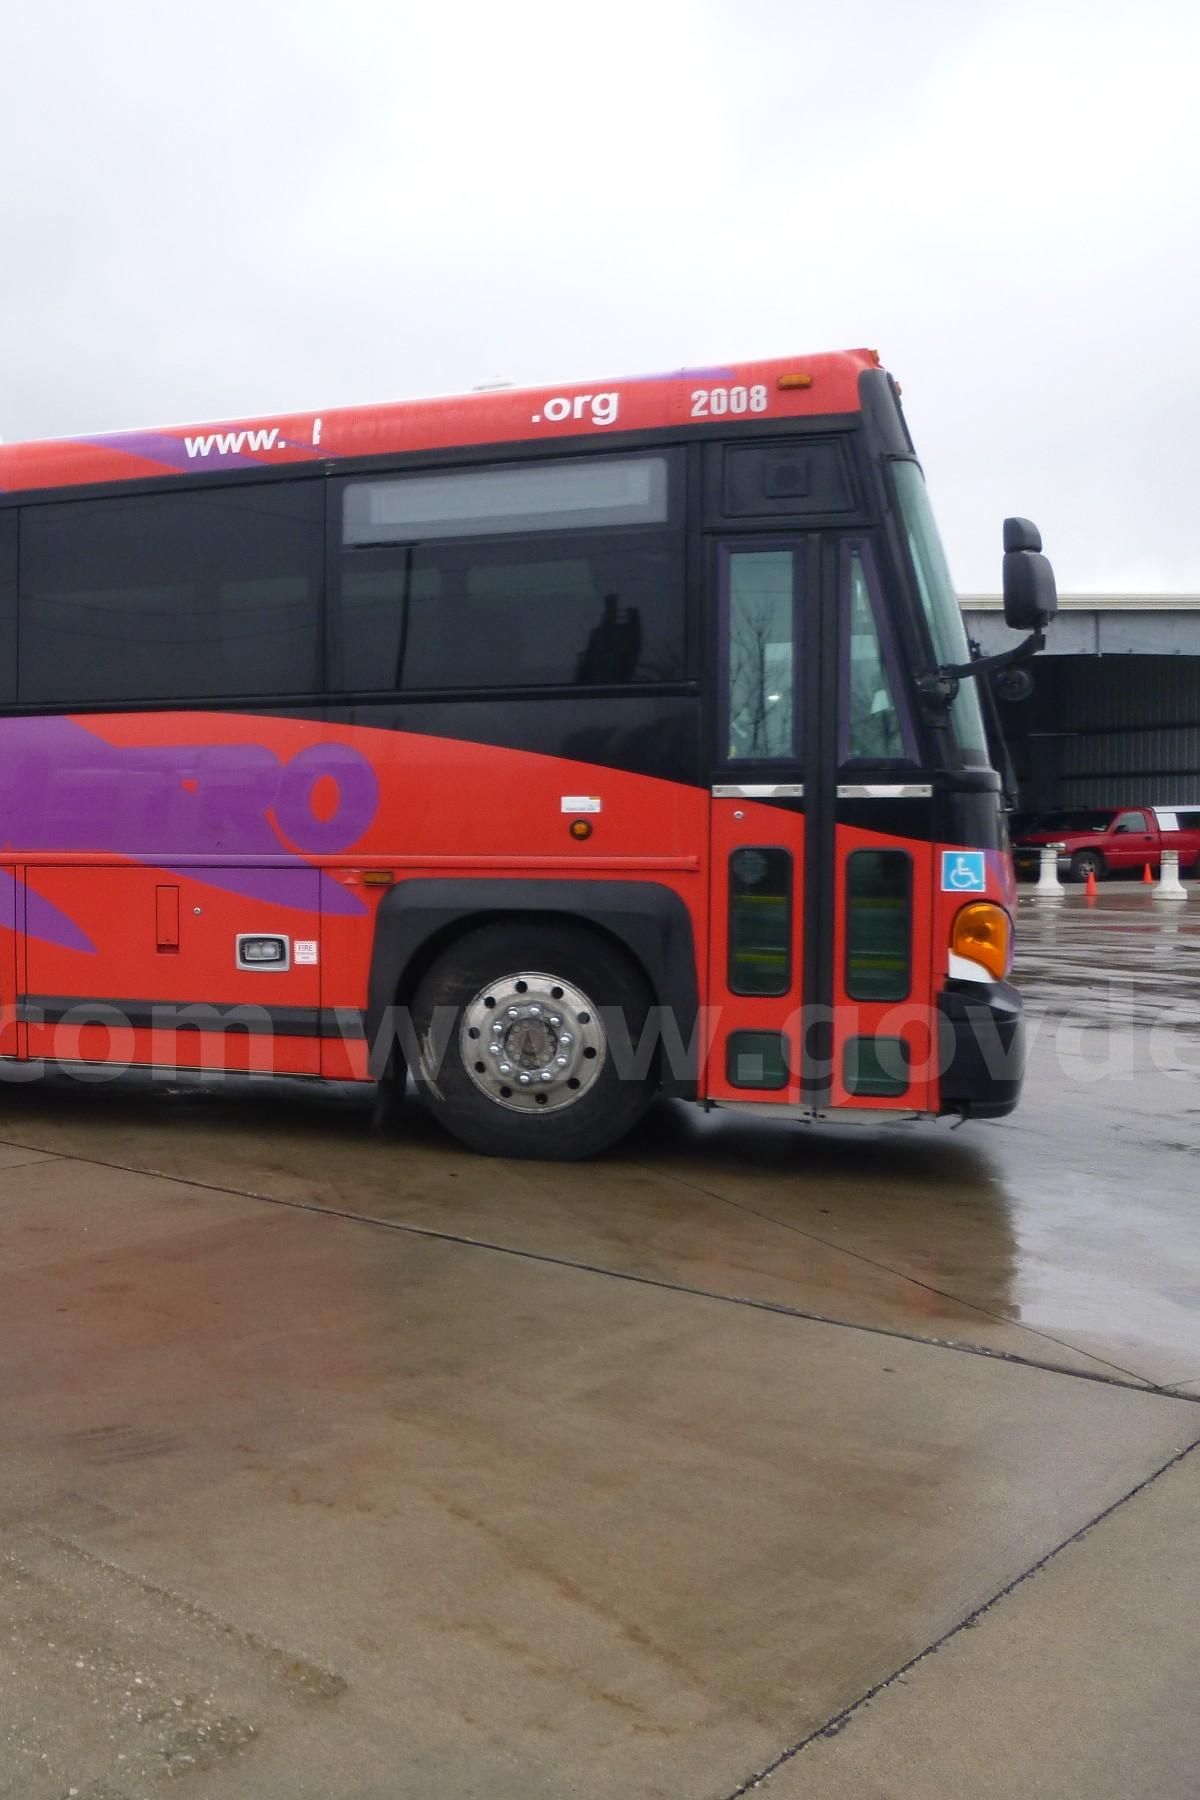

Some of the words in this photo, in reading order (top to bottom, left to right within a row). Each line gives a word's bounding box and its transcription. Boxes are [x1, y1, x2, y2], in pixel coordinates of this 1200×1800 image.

[184, 428, 287, 458] www.
[531, 392, 619, 426] .org
[690, 384, 768, 417] 2008
